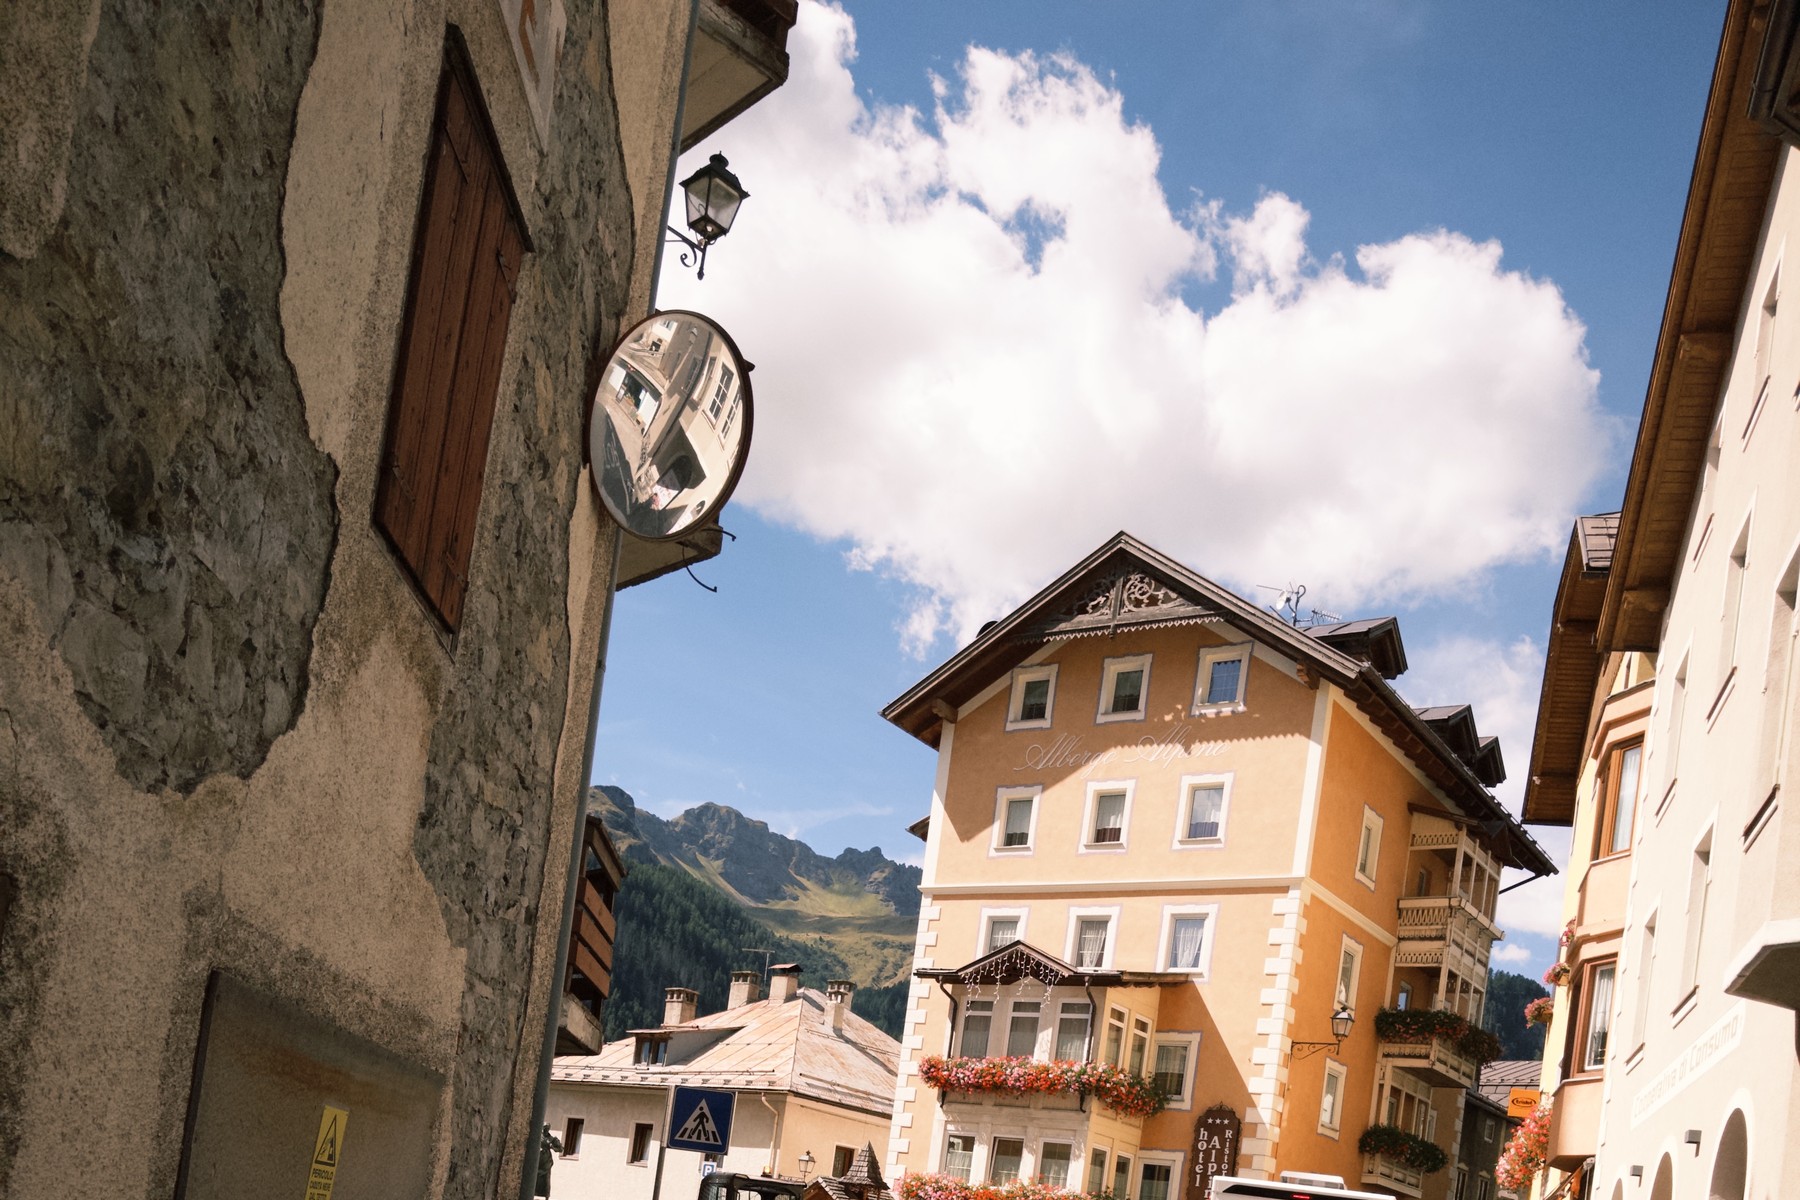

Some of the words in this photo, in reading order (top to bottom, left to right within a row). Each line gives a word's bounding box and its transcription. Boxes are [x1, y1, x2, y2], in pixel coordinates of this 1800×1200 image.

[1012, 732, 1120, 780] Albergo
[1124, 723, 1233, 769] Alpino
[1689, 1013, 1740, 1073] Consumo
[312, 1167, 334, 1181] PERICOLO
[1194, 1127, 1208, 1187] hotel
[1221, 1129, 1233, 1177] Ristor
